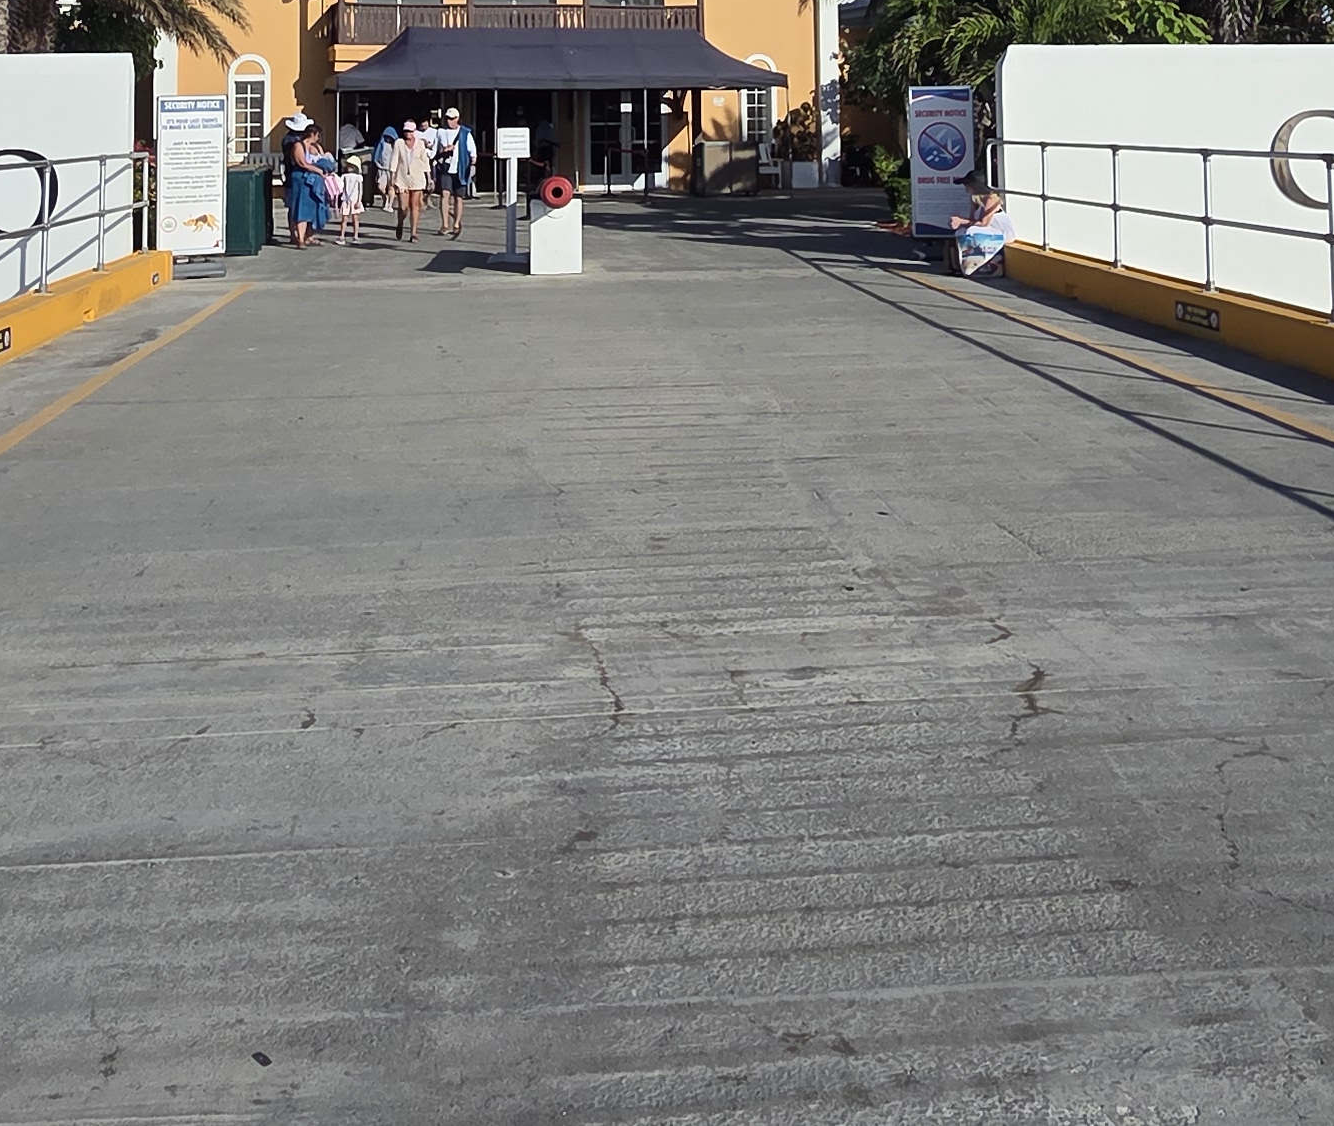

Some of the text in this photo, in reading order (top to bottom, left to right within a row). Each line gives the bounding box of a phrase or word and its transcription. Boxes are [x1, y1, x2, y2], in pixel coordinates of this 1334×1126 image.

[164, 100, 221, 110] SECURITY NOTICE
[914, 109, 967, 118] SECURITY NOTICE
[936, 176, 951, 184] FREE
